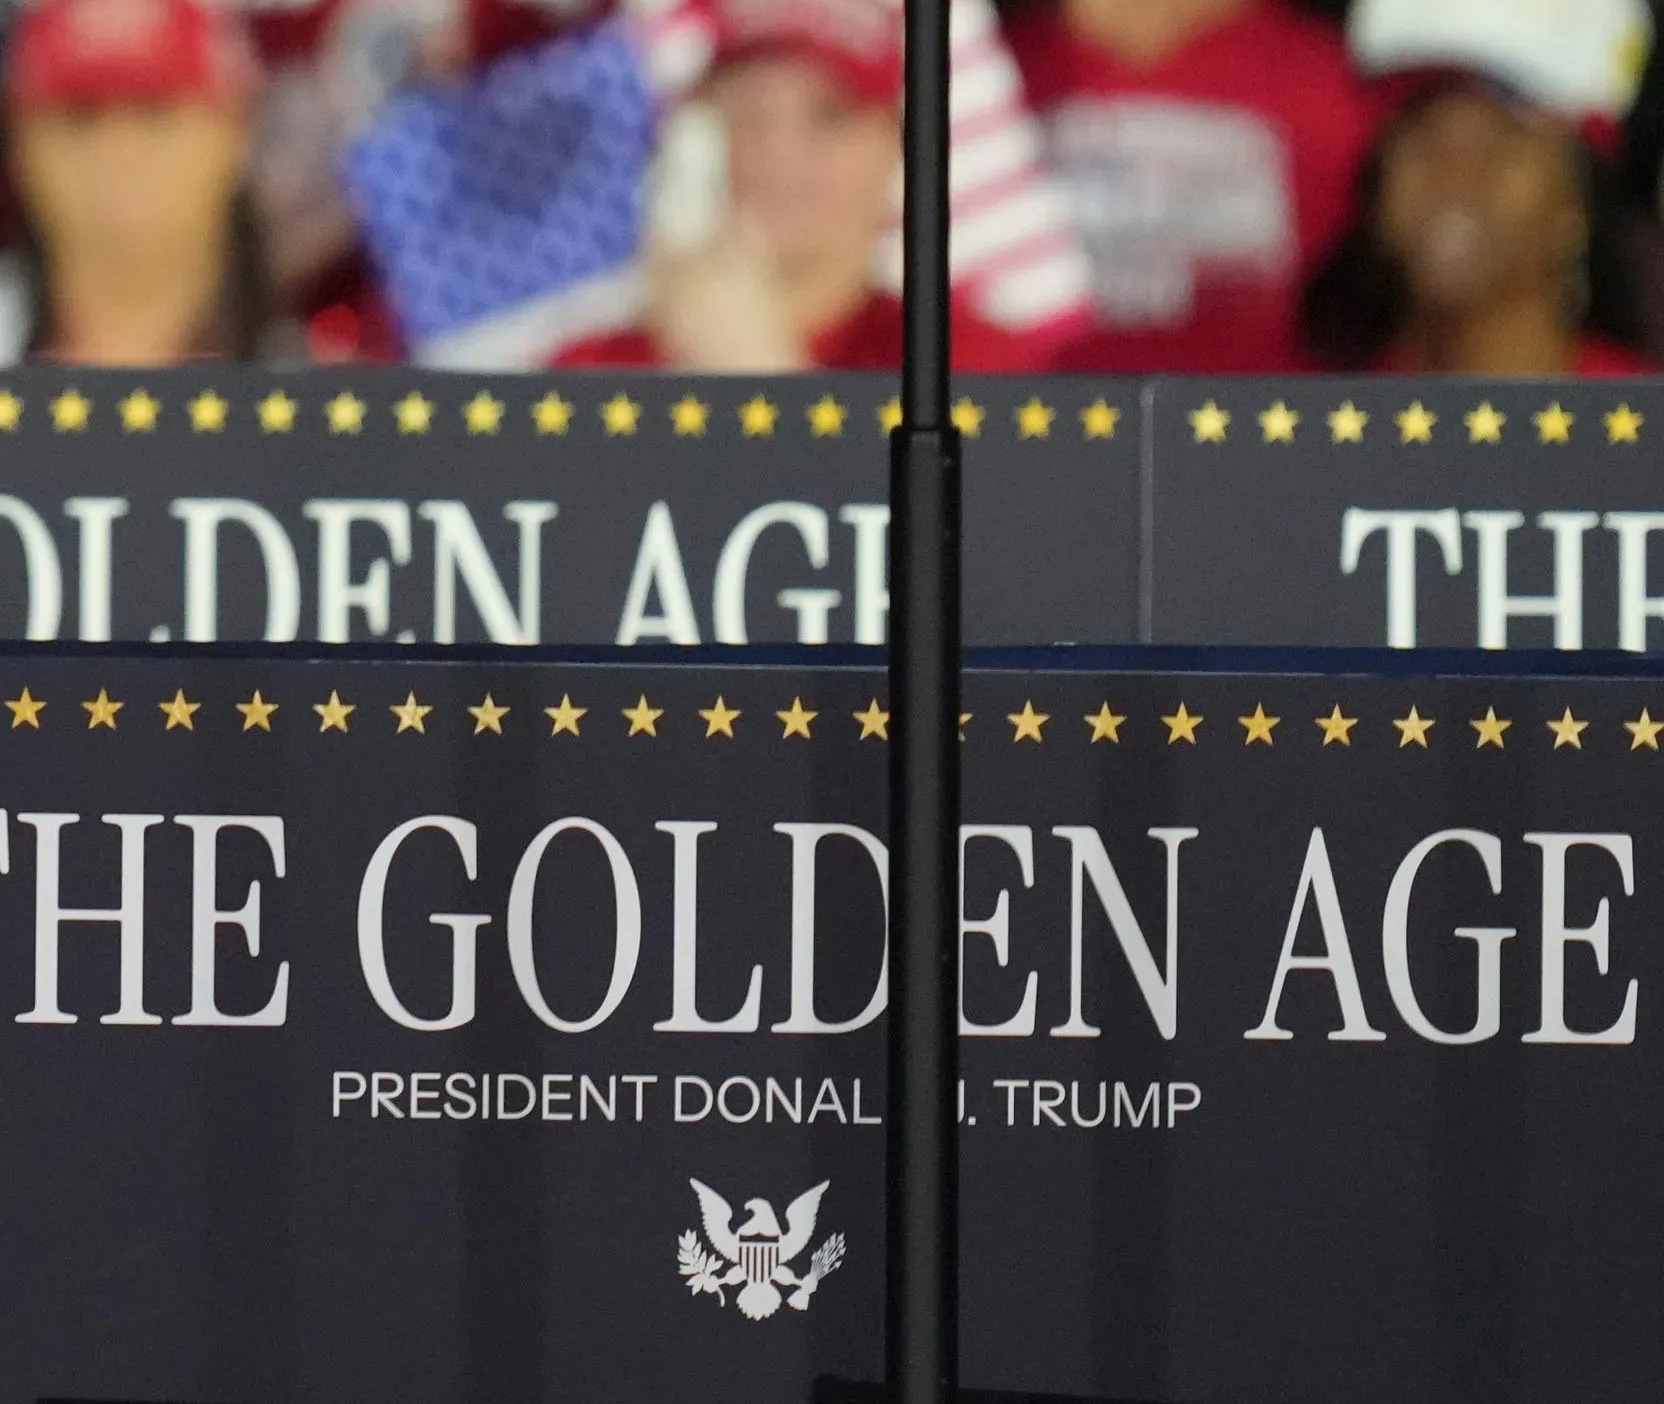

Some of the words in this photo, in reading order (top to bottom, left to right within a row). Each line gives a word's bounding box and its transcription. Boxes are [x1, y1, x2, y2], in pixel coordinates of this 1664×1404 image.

[358, 816, 1198, 1040] GOLDEN
[1244, 827, 1638, 1044] AGE
[333, 1072, 657, 1121] PRESIDENT
[675, 1076, 881, 1123] DONAL
[994, 1080, 1201, 1127] TRUMP
